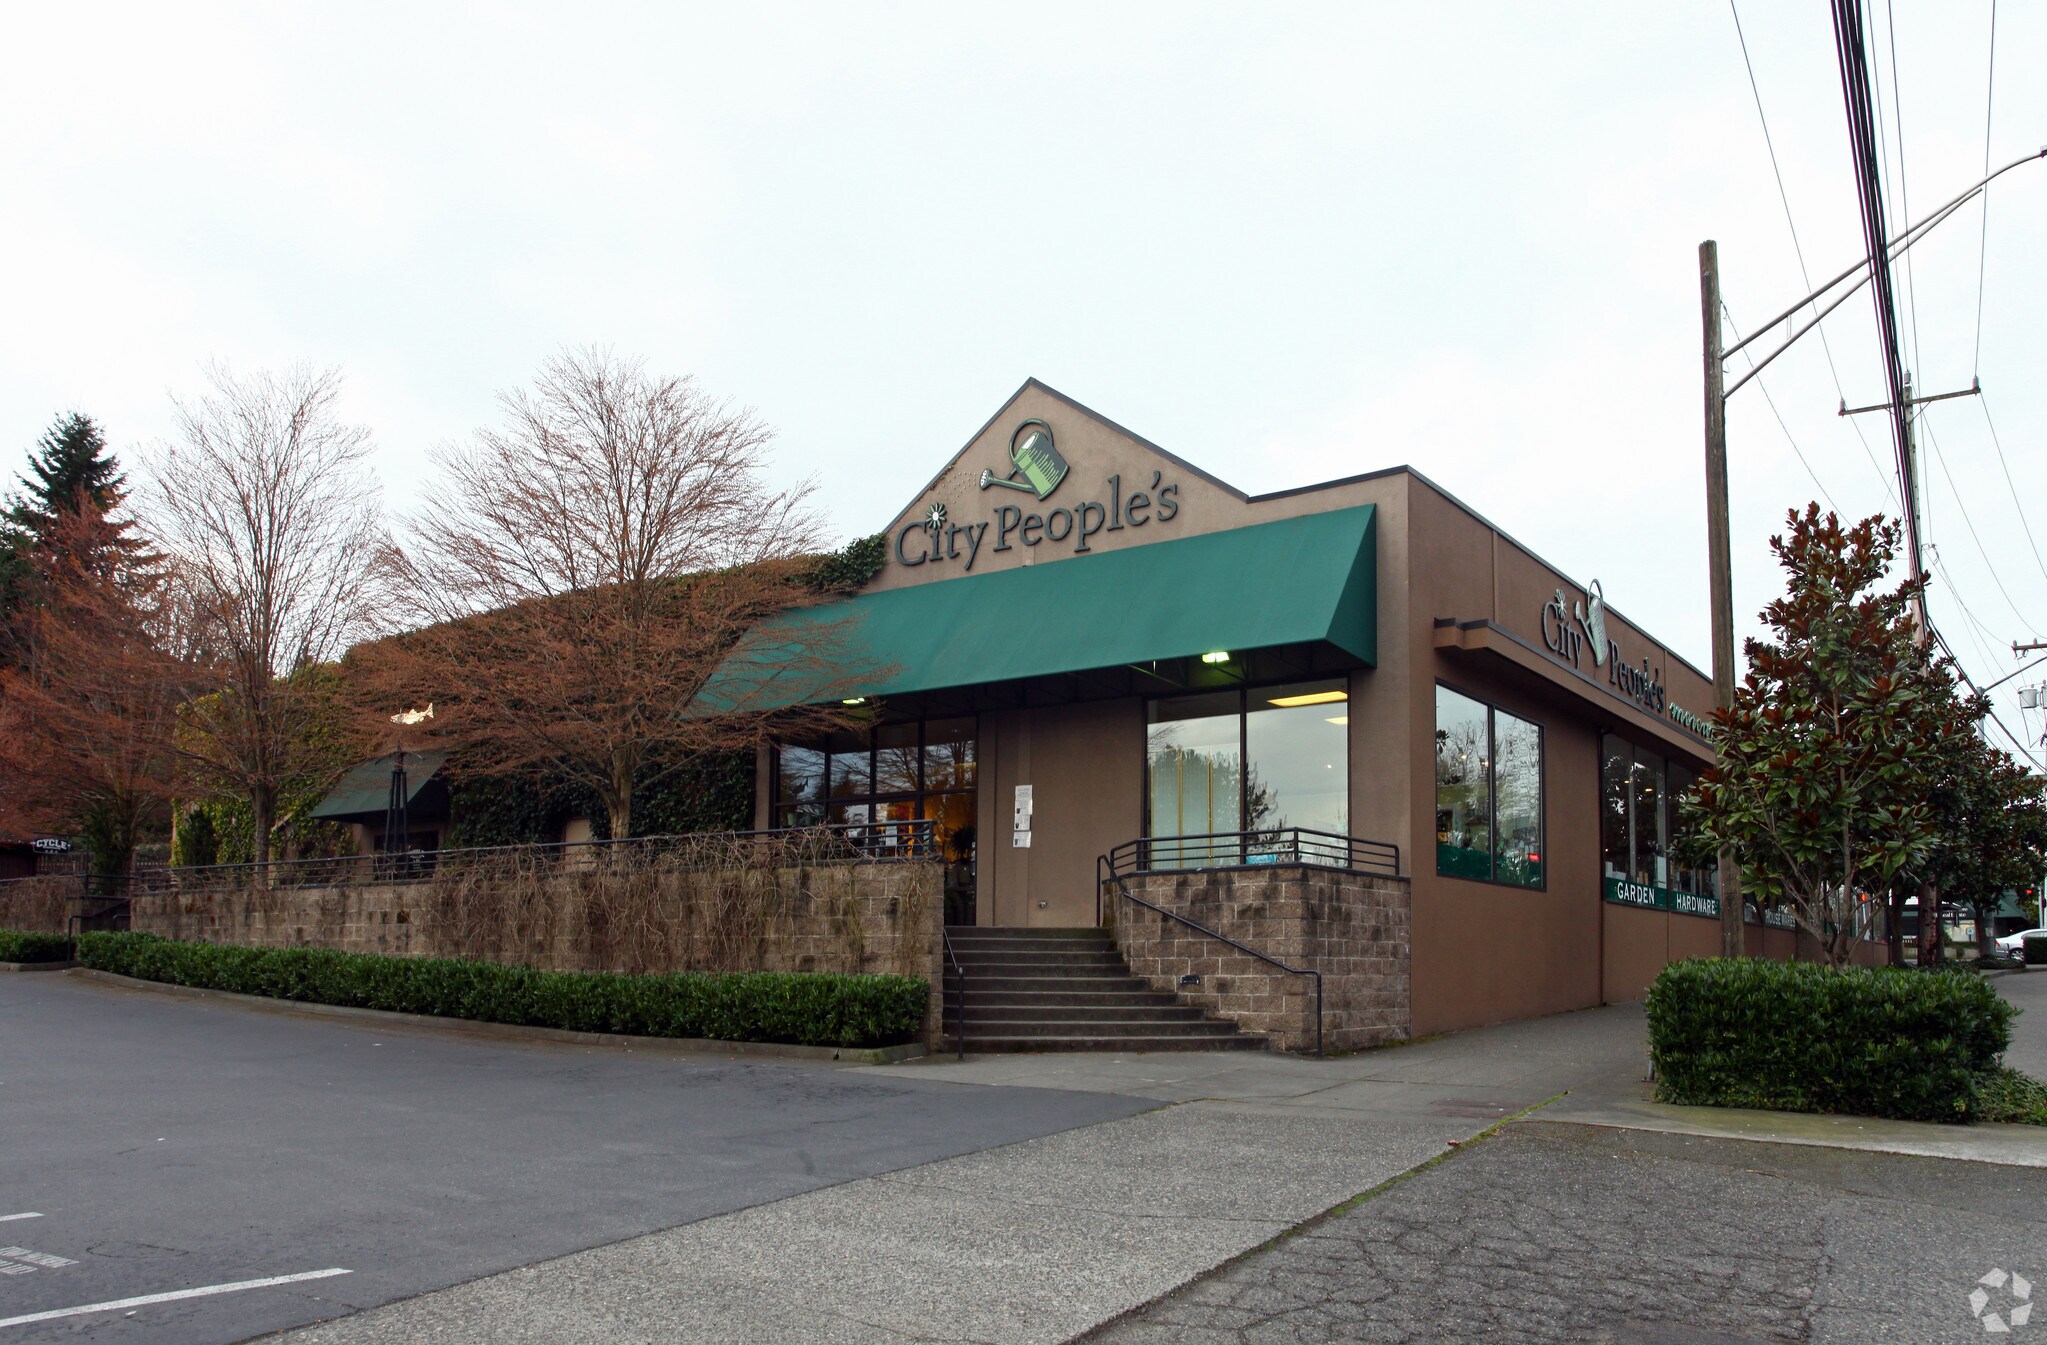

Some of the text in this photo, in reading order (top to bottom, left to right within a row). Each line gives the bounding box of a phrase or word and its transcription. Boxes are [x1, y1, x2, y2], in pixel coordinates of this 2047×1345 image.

[895, 471, 1179, 571] City People's
[1542, 596, 1664, 713] City People's
[36, 839, 67, 850] CYCLE
[1617, 881, 1655, 905] GARDEN
[1676, 893, 1716, 916] HARDWARE
